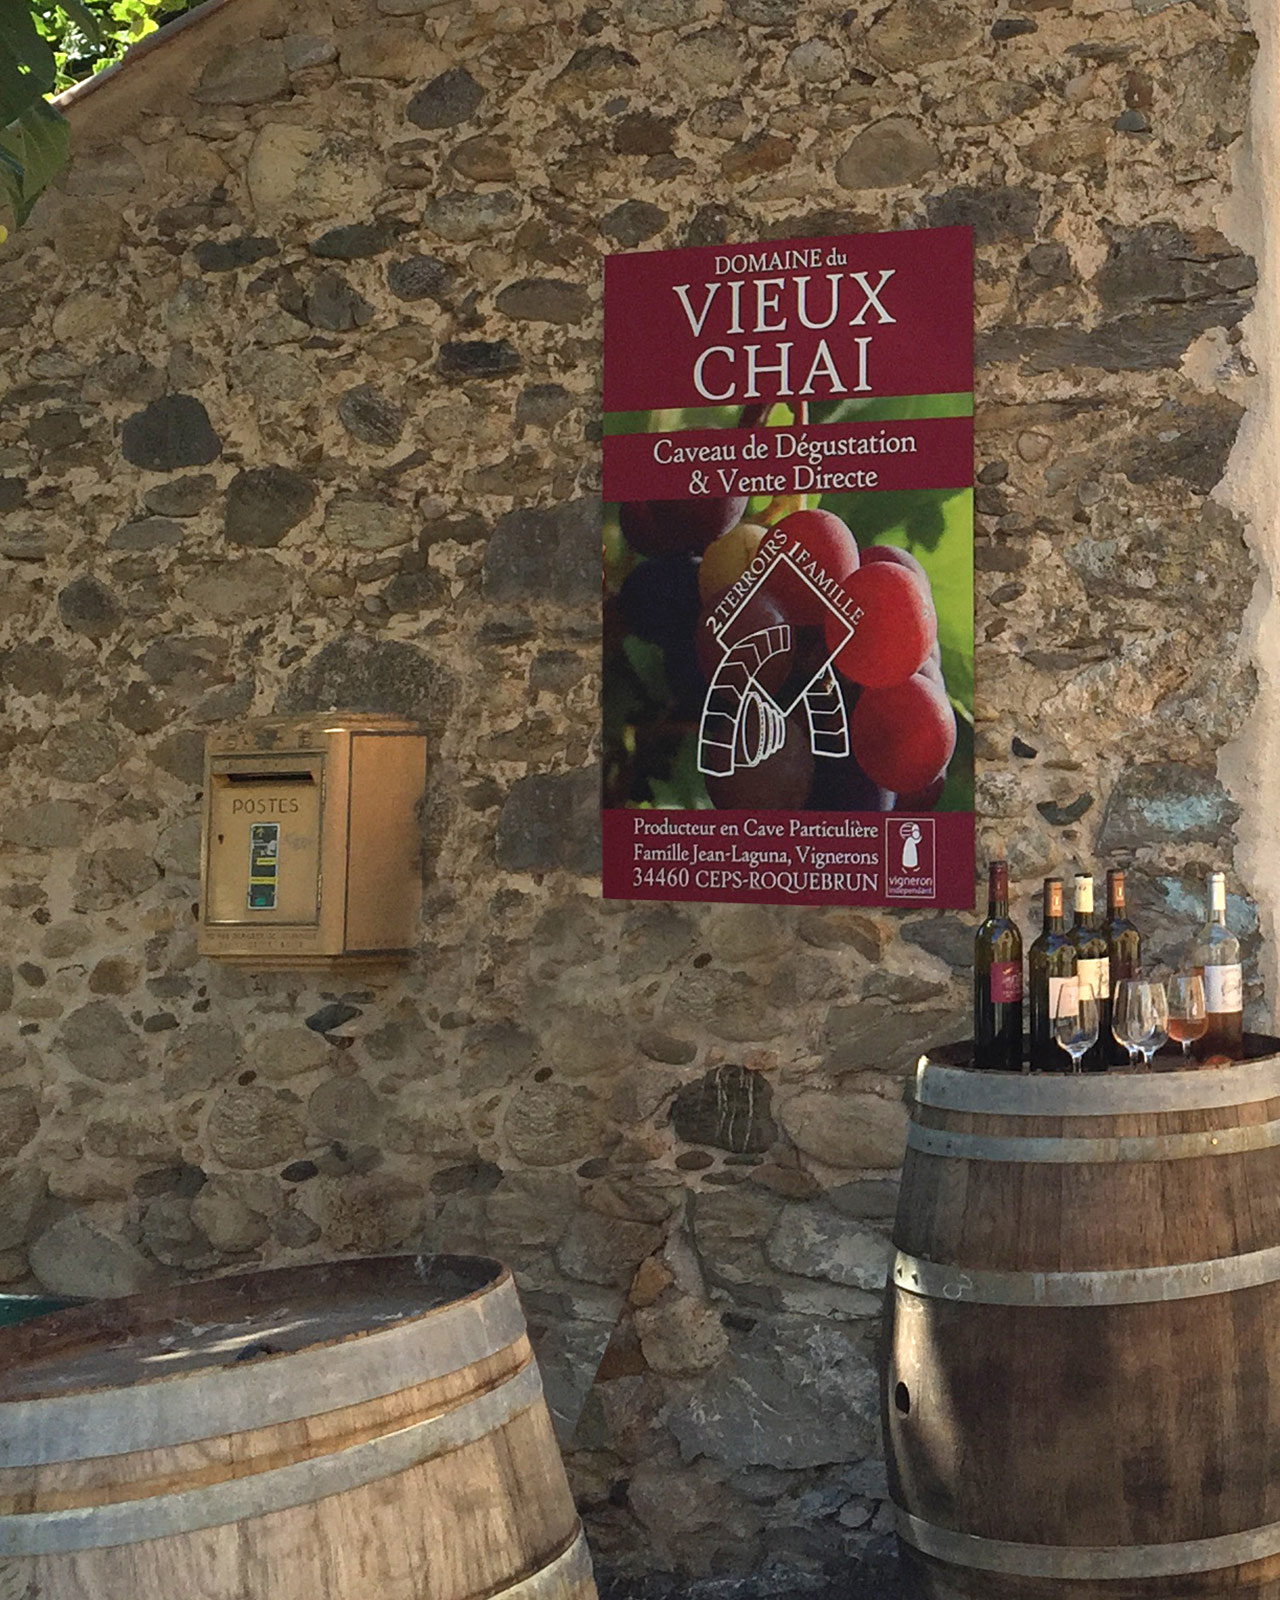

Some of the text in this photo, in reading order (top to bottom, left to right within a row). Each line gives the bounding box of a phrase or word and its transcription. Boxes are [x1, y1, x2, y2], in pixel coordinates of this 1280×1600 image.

[714, 247, 848, 276] DOMAINE du
[672, 269, 897, 338] VIEUX
[693, 337, 873, 401] CHAI
[653, 430, 917, 465] Caveau de Dégustation
[688, 465, 878, 495] & Vente Directe
[705, 528, 789, 634] 2 TERROIRS
[787, 541, 866, 626] 1 FAMILLE
[232, 798, 300, 815] POSTES
[633, 817, 879, 838] Producteur en Cave Particulière
[633, 843, 879, 869] Famille Jean-Laguna, Vignerons
[632, 867, 879, 894] 34460 CEPS-ROQUEBRUN
[888, 875, 933, 888] vigneron
